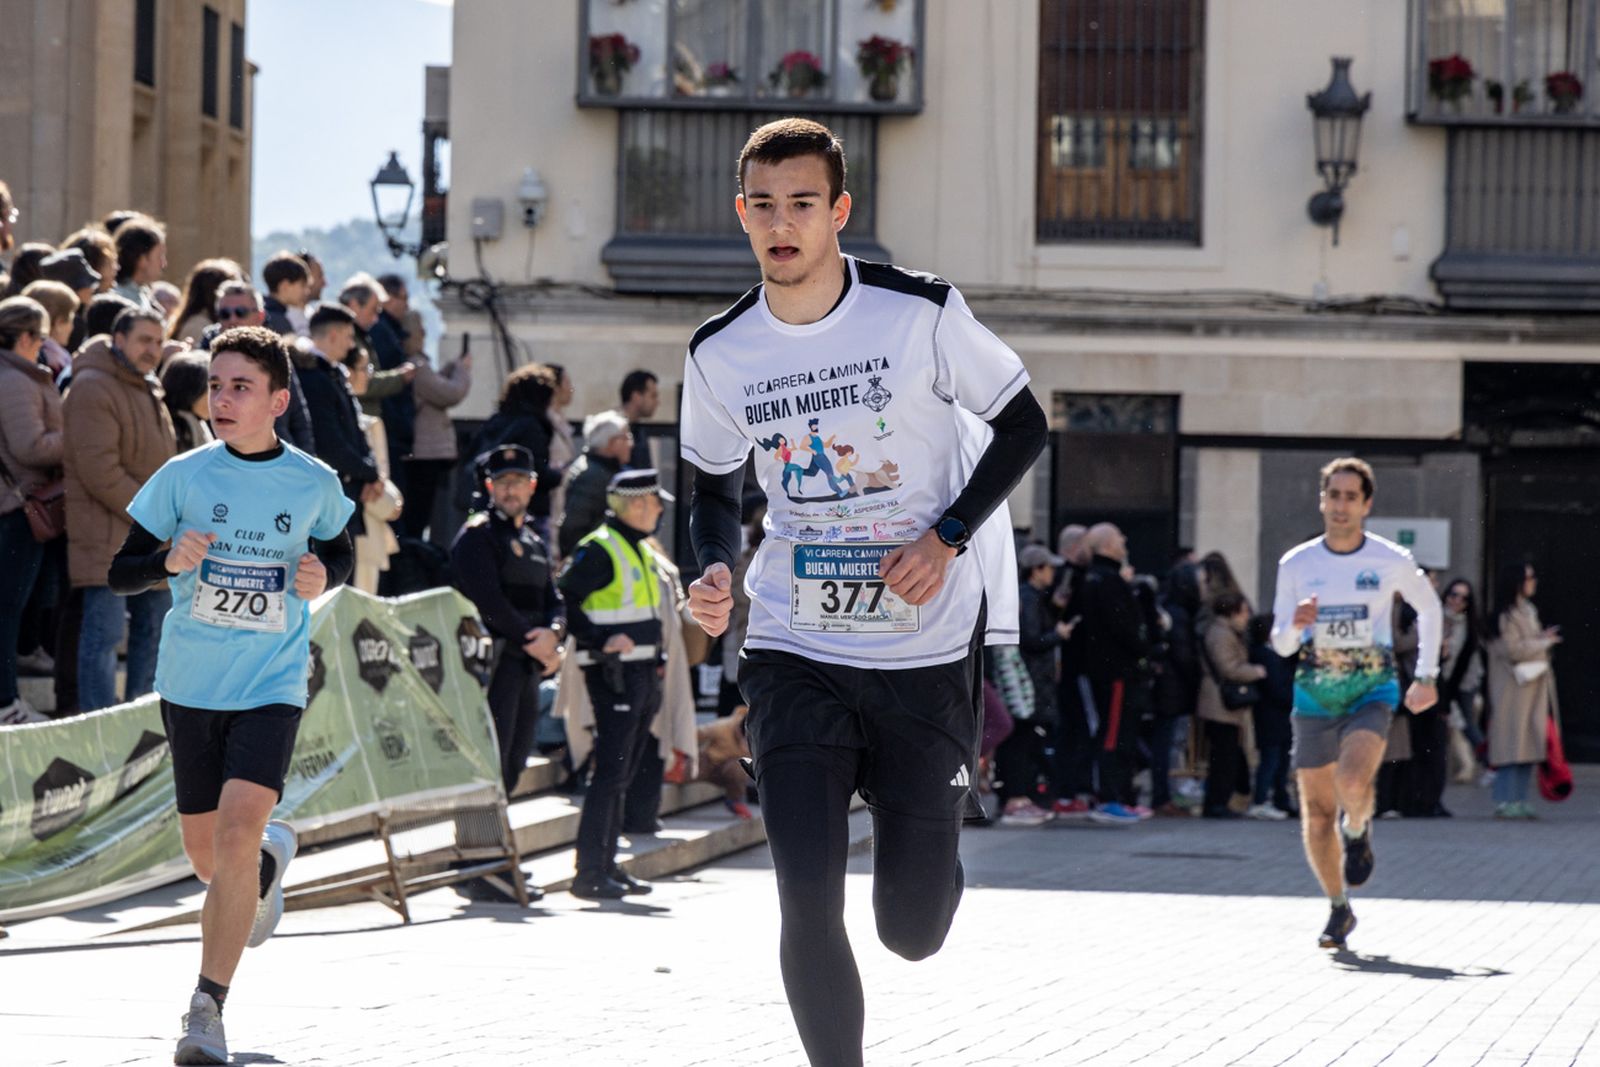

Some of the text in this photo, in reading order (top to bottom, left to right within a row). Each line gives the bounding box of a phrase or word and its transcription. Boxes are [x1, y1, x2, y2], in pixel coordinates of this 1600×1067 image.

[743, 356, 890, 397] VI CARRERA CAMINATA
[745, 384, 860, 426] BUENA MUERTE
[234, 529, 266, 541] CLUB
[209, 541, 285, 560] SAN IGNACIO
[805, 549, 814, 558] VI
[815, 548, 852, 558] CARRERA
[805, 562, 879, 576] BUENA MUERTE
[208, 572, 265, 590] BUENA MUERTE
[213, 588, 268, 616] 270
[820, 580, 886, 614] 377
[1326, 620, 1356, 638] 401
